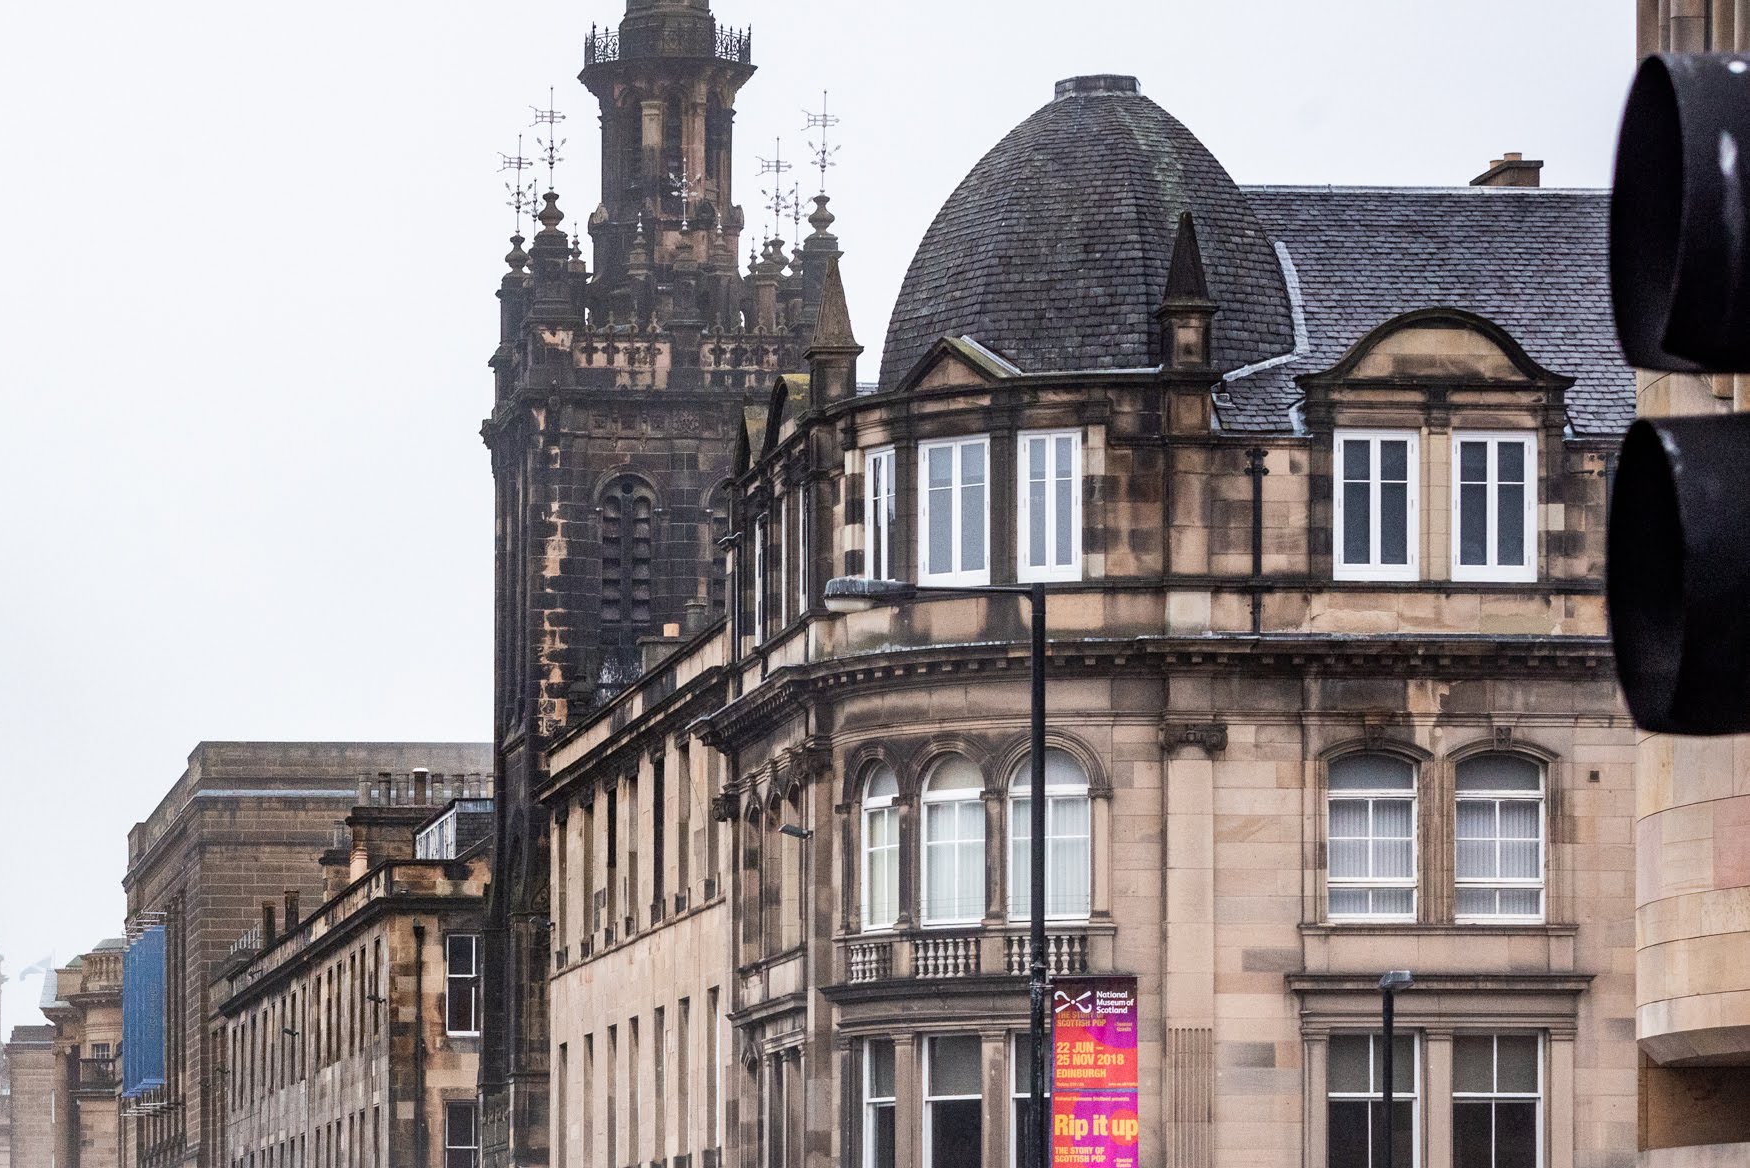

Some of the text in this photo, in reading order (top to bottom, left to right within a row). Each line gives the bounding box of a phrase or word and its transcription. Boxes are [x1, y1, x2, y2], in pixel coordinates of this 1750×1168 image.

[1096, 990, 1128, 998] National
[1096, 1006, 1128, 1014] Scotland
[1056, 1042, 1070, 1053] 22
[1072, 1042, 1094, 1053] JUN
[1056, 1054, 1124, 1066] 25 NOV 2018
[1056, 1068, 1106, 1078] EDINBURGH
[1054, 1114, 1138, 1140] Rip it up
